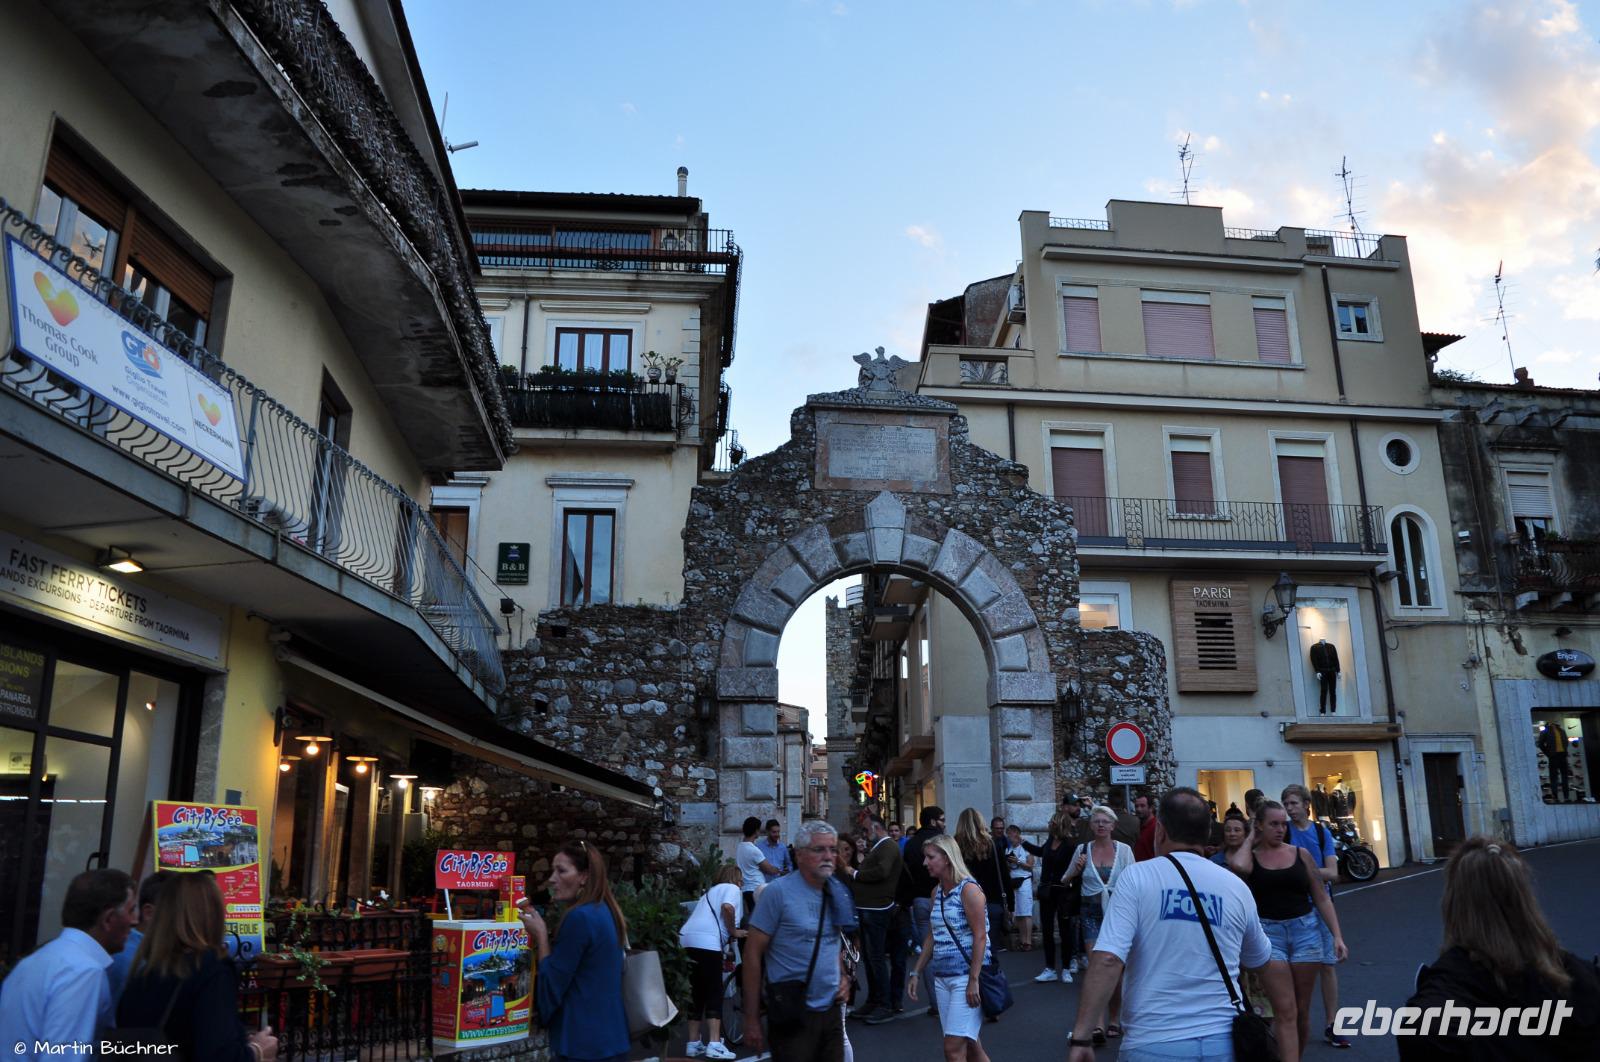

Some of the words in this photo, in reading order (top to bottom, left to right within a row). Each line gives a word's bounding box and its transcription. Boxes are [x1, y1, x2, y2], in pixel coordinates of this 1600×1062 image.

[20, 303, 68, 344] Thomas
[70, 337, 98, 364] Cook
[45, 336, 79, 368] Group
[10, 548, 48, 577] FAST
[50, 564, 95, 593] FERRY
[98, 581, 148, 613] TICKETS
[1193, 586, 1232, 599] PARISI
[27, 575, 81, 604] EXCURSIONS
[89, 598, 134, 623] DEPARTURE
[134, 614, 154, 630] FROM
[155, 621, 191, 642] TAORMINA
[1196, 600, 1230, 608] TAORMINA
[0, 687, 31, 705] PANAREA
[172, 806, 243, 831] CityBySee
[440, 852, 508, 880] CityBySee
[456, 881, 495, 889] TAORMINA
[472, 928, 529, 955] CityBySee
